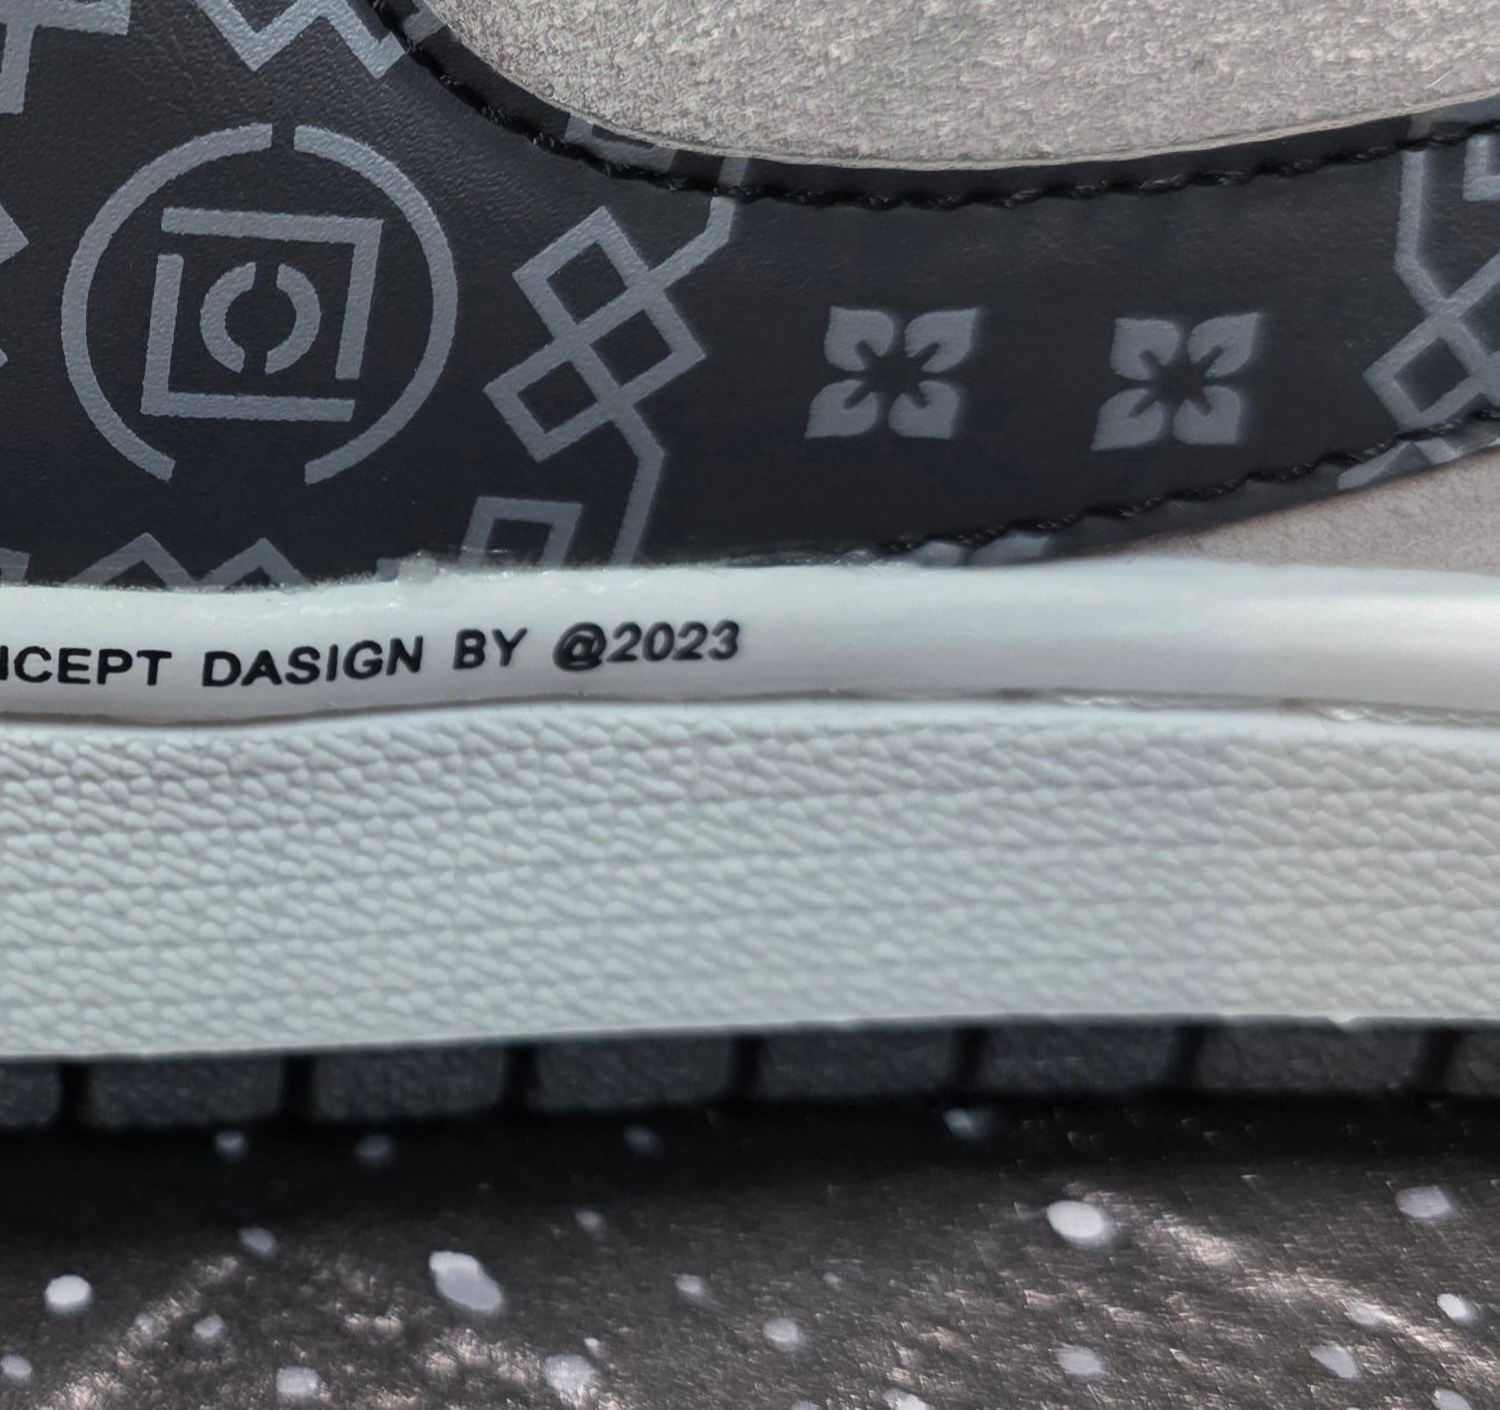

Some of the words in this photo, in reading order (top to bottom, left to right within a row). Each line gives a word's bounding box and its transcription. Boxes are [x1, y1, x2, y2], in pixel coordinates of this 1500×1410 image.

[200, 633, 426, 689] DASIGN
[450, 626, 530, 672] BY
[550, 619, 743, 675] @2023
